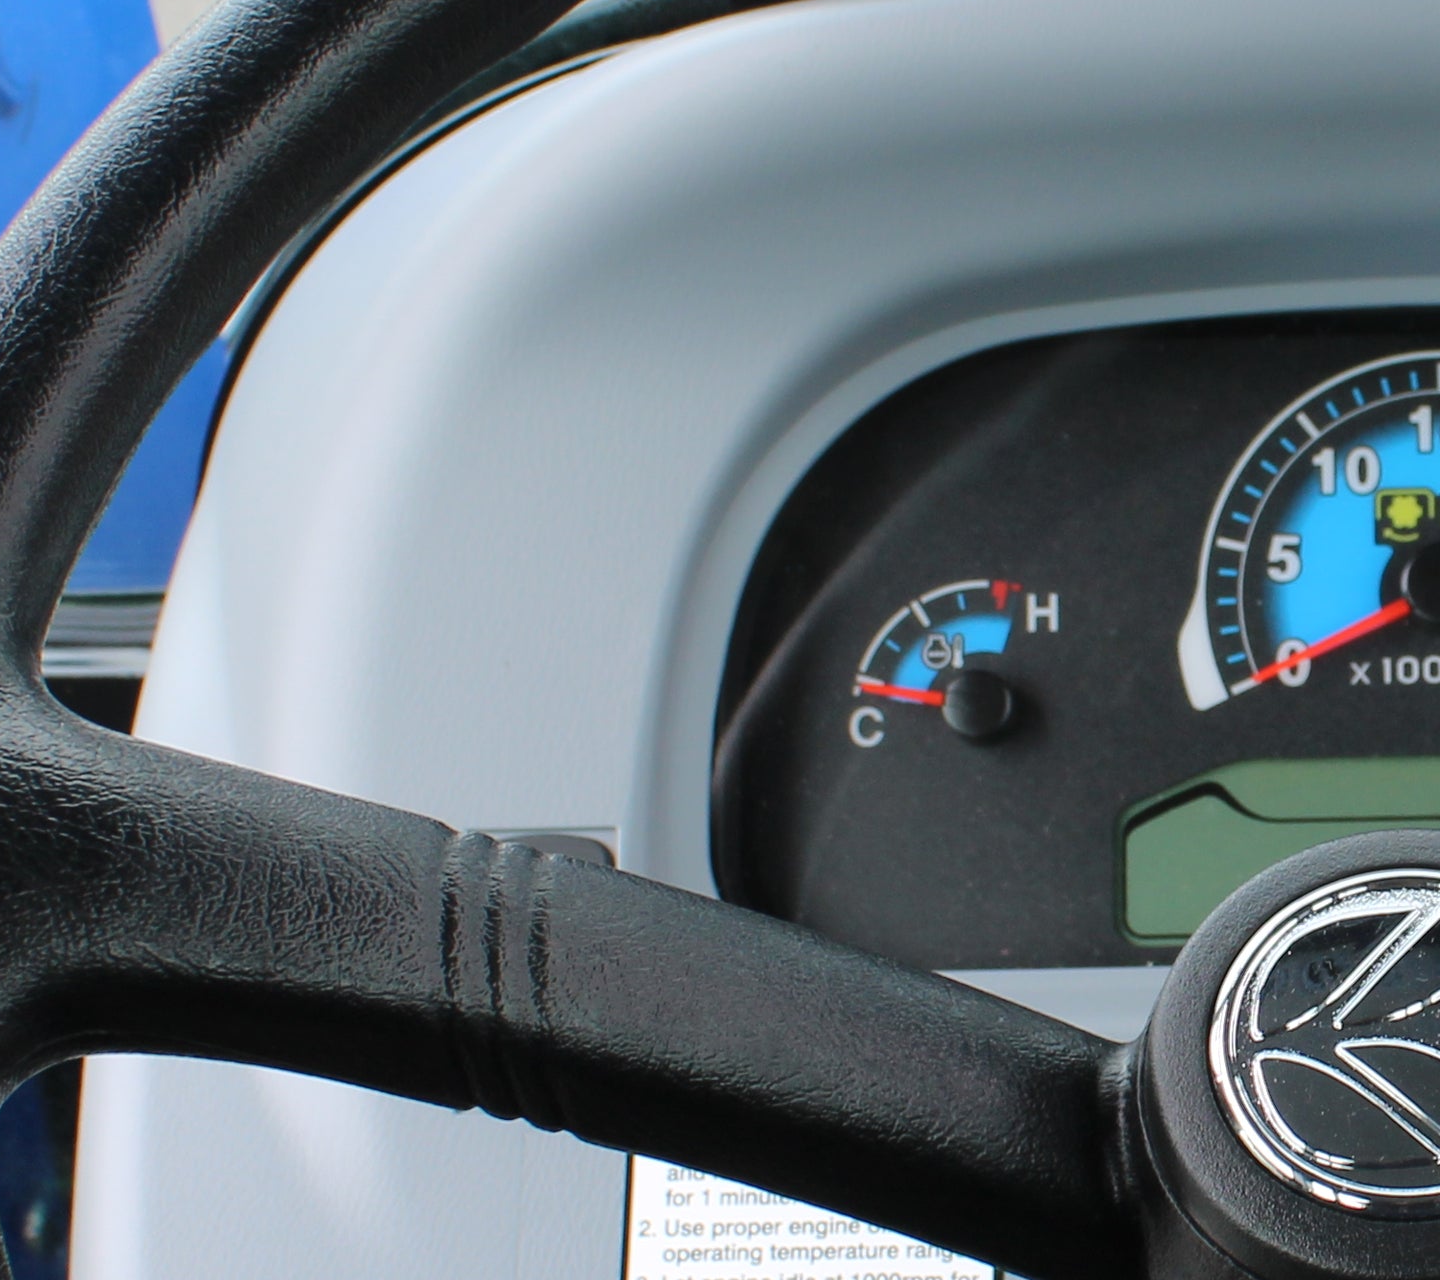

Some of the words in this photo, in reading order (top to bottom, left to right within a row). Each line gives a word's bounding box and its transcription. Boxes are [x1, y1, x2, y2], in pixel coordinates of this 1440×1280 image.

[1312, 446, 1381, 496] 10
[1266, 534, 1302, 584] 5
[1025, 592, 1059, 633] H
[1275, 639, 1312, 688] 0
[849, 705, 885, 748] C
[666, 1188, 694, 1207] for
[702, 1188, 711, 1207] 1
[719, 1188, 797, 1207] minute
[639, 1219, 657, 1237] 2.
[664, 1219, 705, 1238] Use
[711, 1219, 781, 1240] proper
[789, 1216, 860, 1240] engine
[663, 1243, 763, 1266] operating
[770, 1242, 899, 1265] temperature
[906, 1244, 962, 1264] rang
